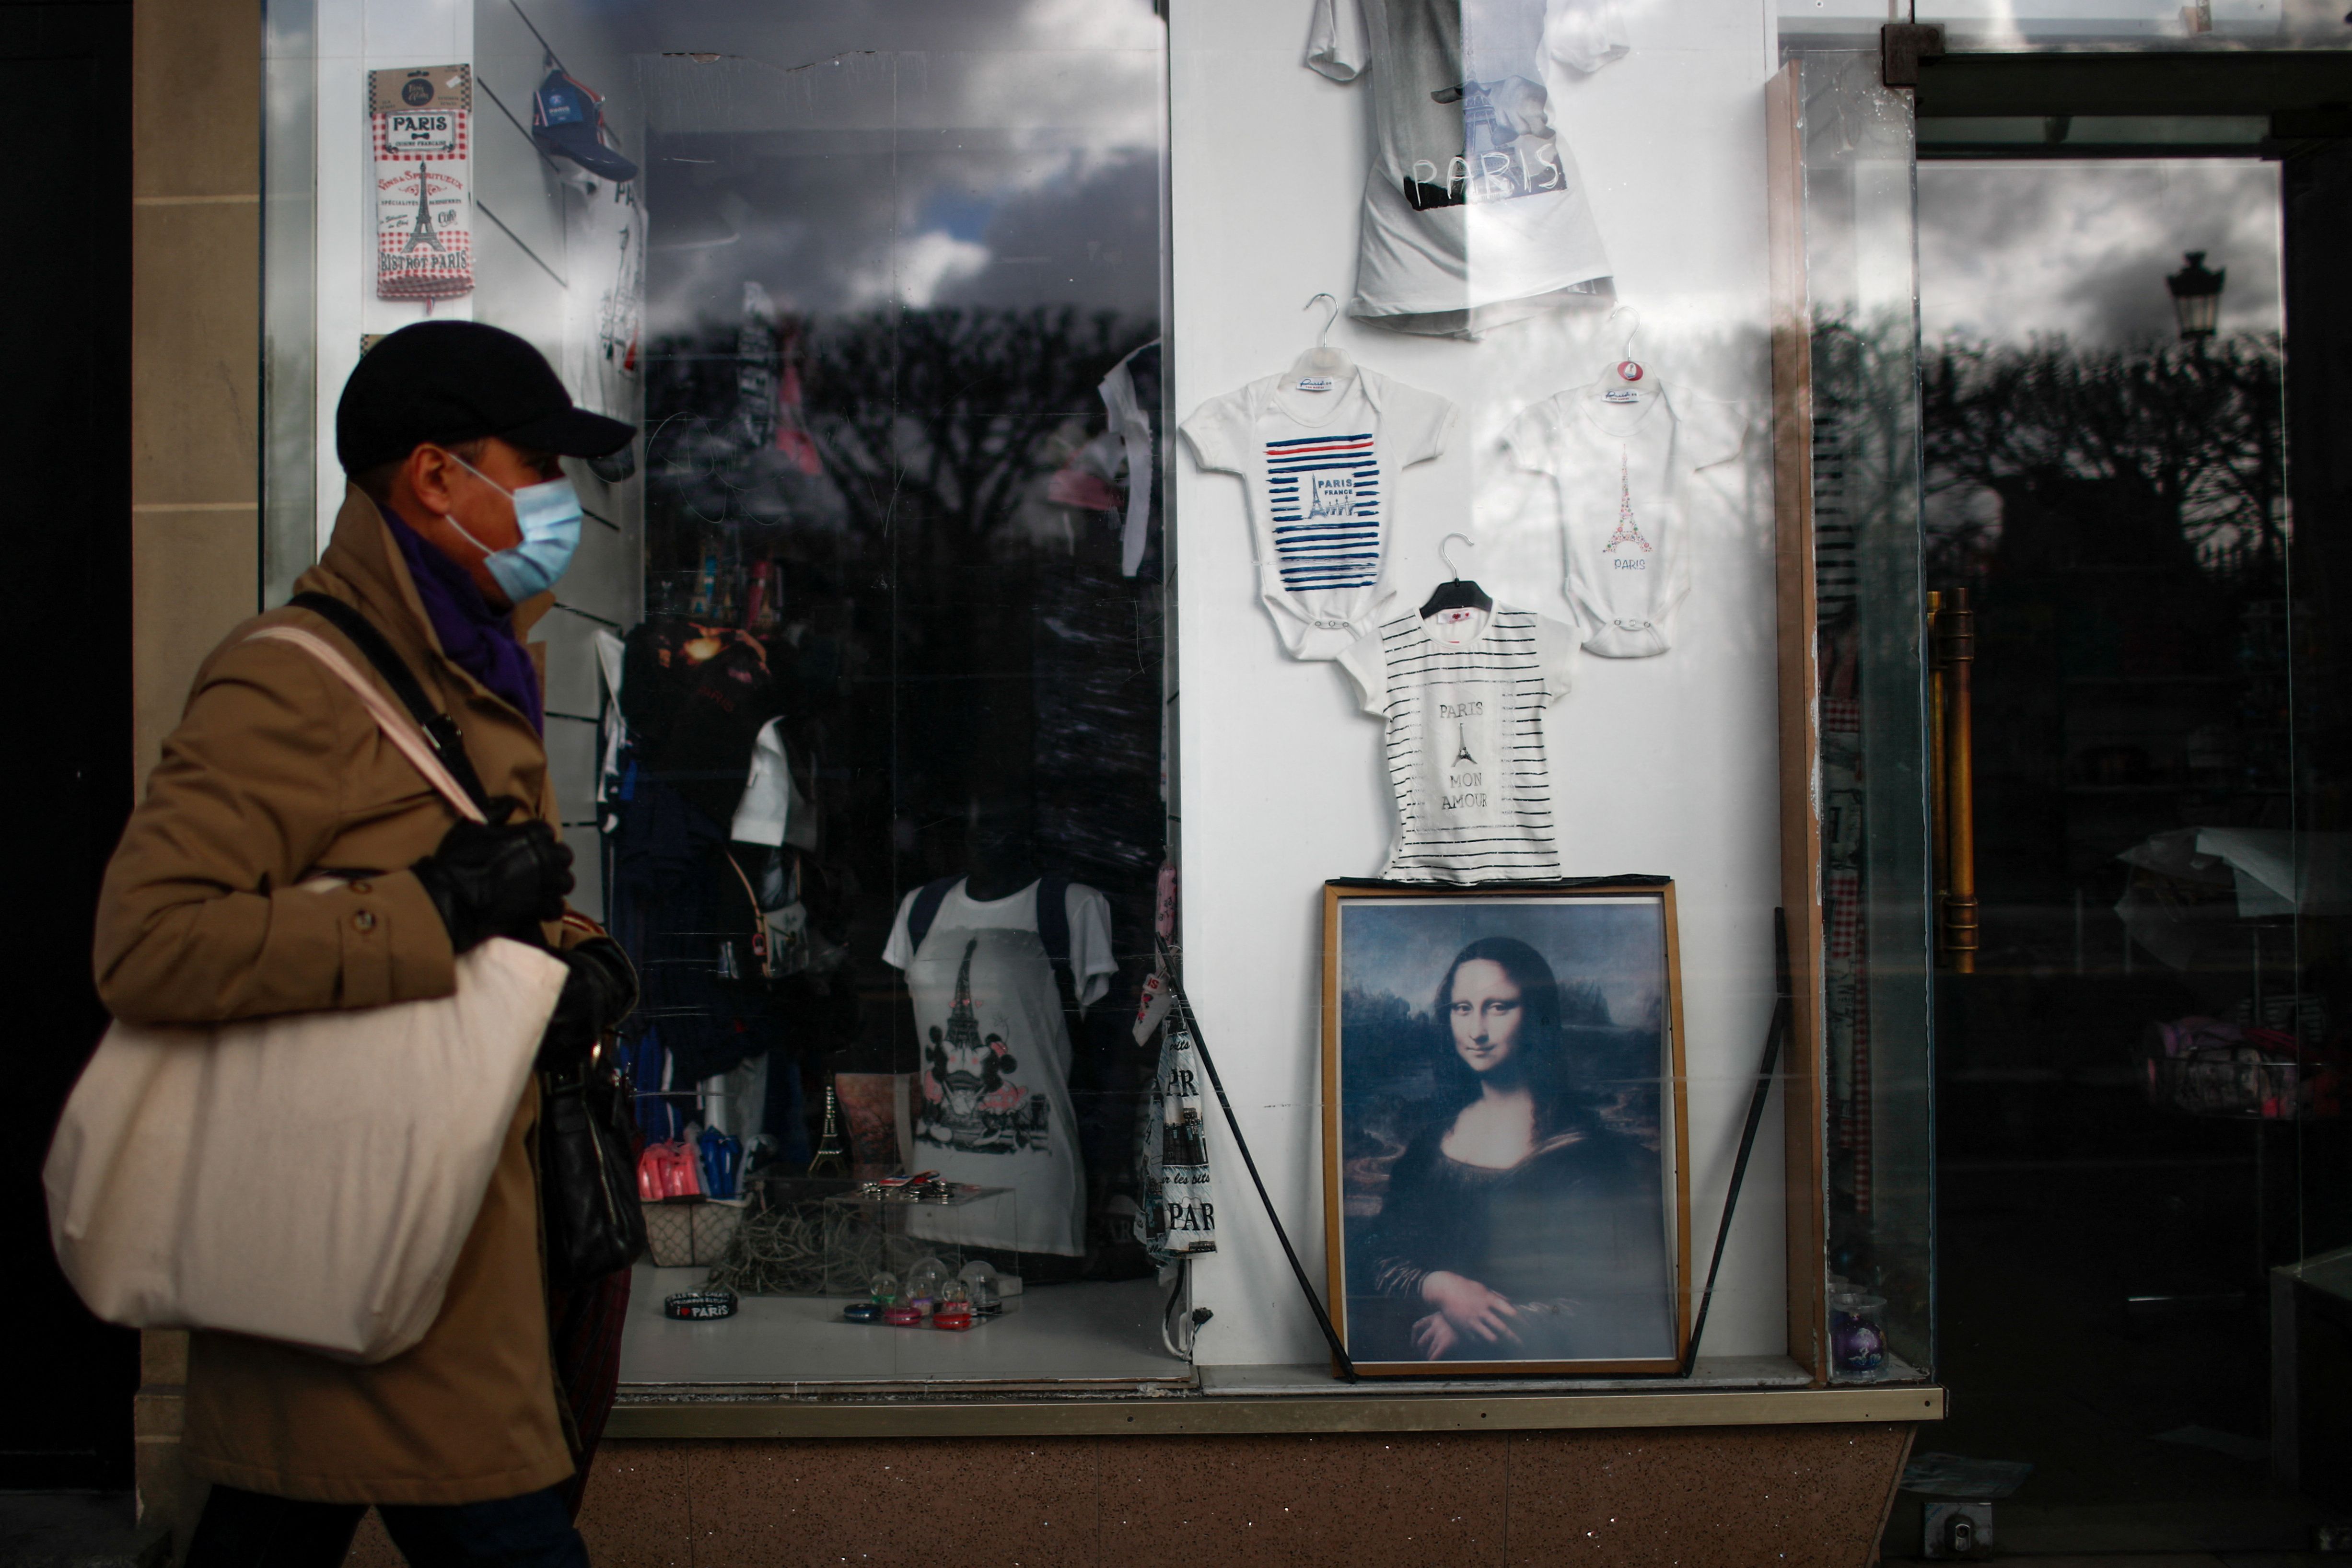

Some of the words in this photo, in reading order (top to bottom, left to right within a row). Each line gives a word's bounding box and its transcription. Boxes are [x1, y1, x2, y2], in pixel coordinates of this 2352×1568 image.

[393, 116, 447, 130] PARIS
[1413, 143, 1558, 207] PARIS
[381, 252, 428, 271] BISTROT
[431, 250, 467, 268] PARIS
[1318, 479, 1352, 488] PARIS
[1615, 559, 1645, 569] PARIS
[1440, 701, 1483, 718] PARIS
[1450, 772, 1482, 788] MON
[1442, 793, 1487, 810] AMOUR
[1175, 1172, 1189, 1185] les
[1168, 1203, 1215, 1231] PAR
